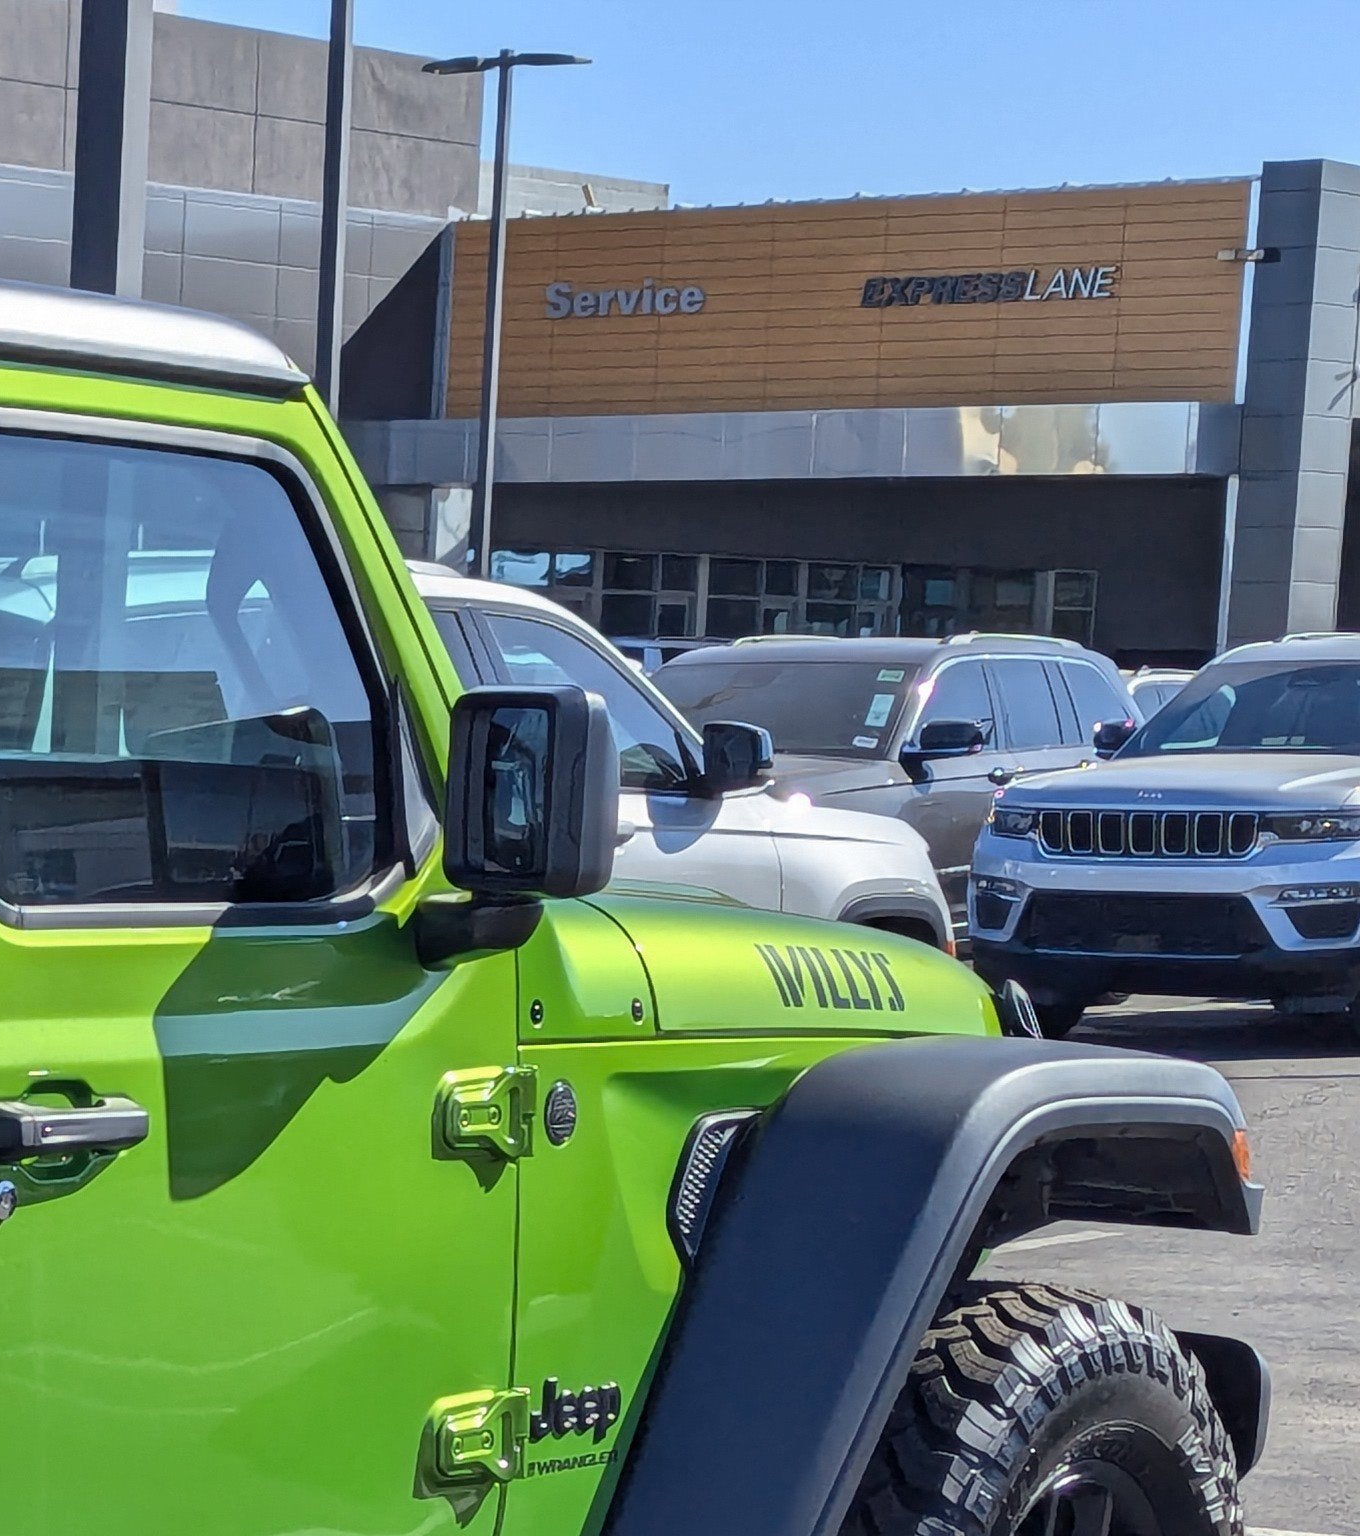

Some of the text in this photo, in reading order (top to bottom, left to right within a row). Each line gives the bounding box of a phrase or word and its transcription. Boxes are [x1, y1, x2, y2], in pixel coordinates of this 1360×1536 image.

[545, 276, 705, 319] Service
[754, 943, 905, 1011] WILLYS
[529, 1376, 622, 1445] Jeep
[536, 1451, 618, 1476] WRANGLER
